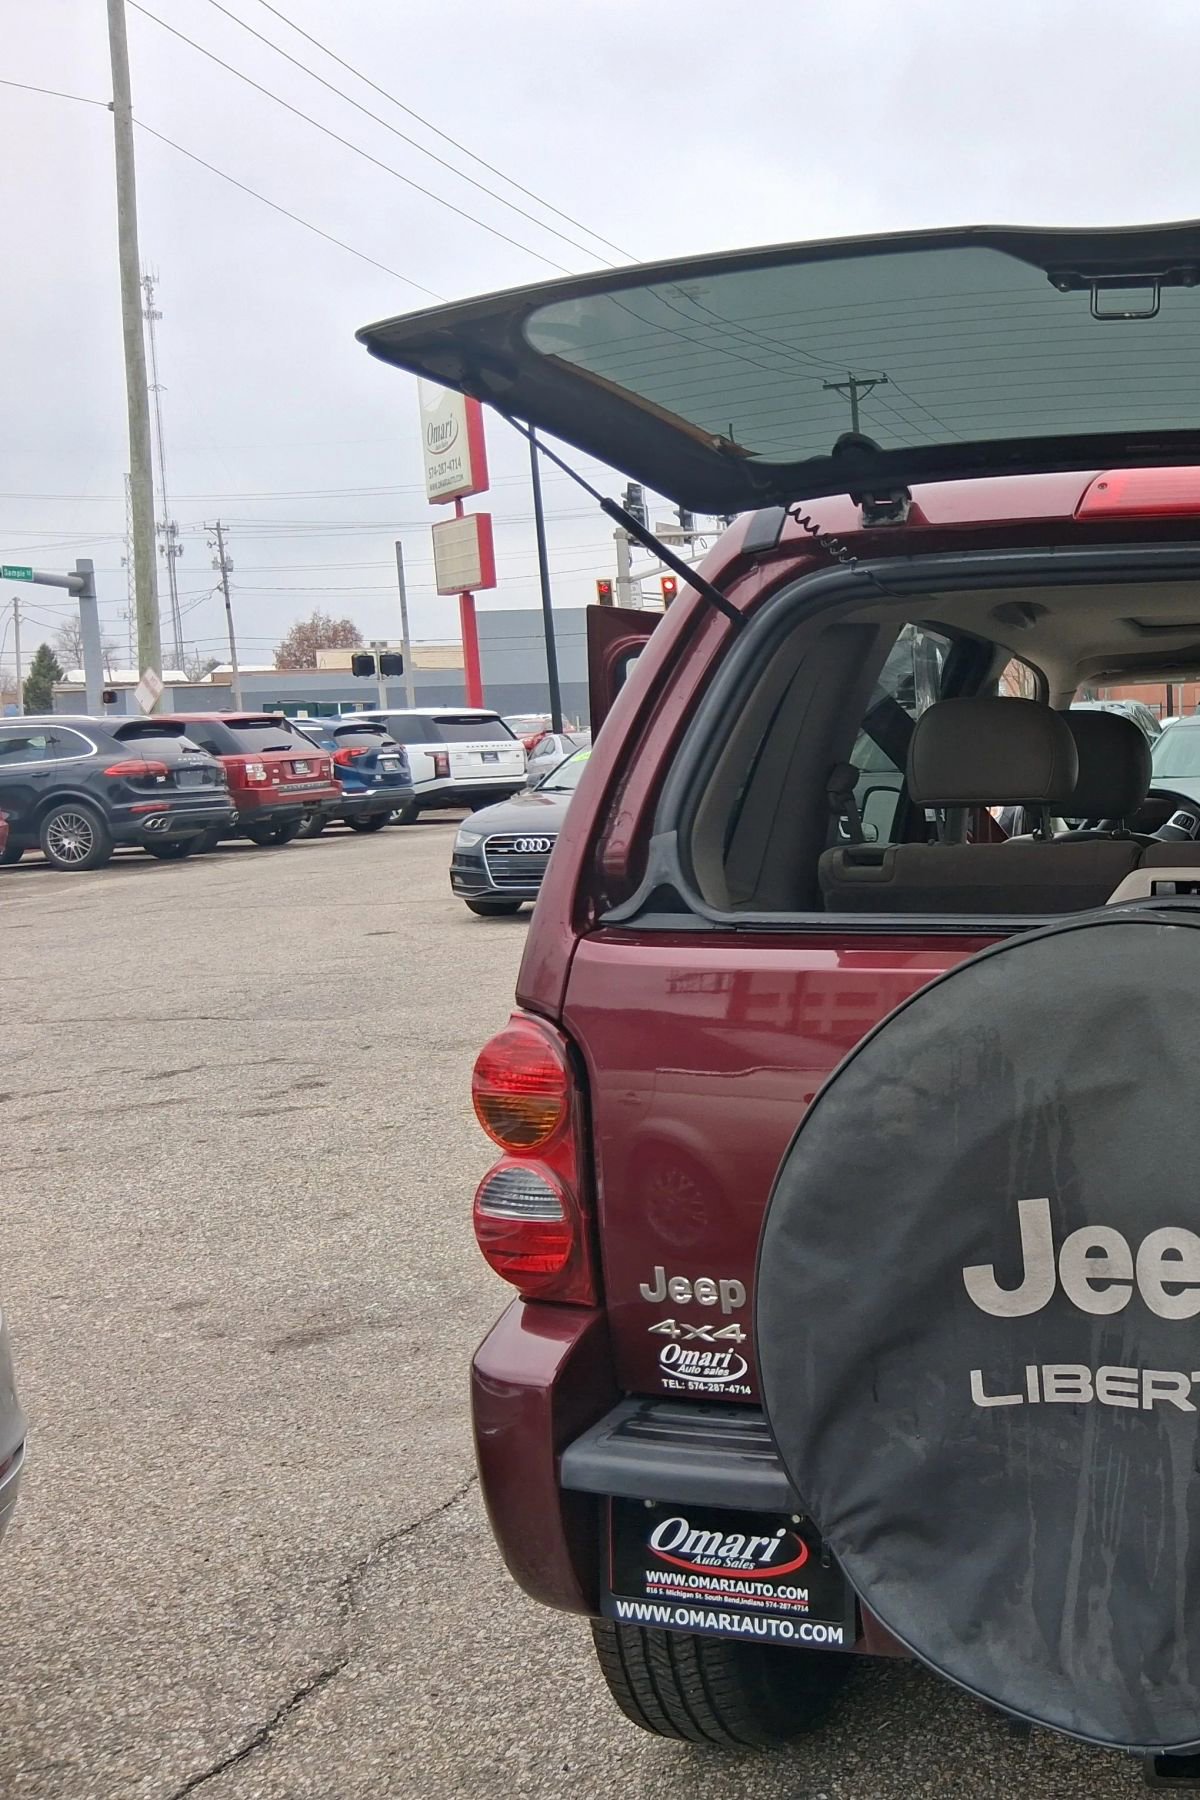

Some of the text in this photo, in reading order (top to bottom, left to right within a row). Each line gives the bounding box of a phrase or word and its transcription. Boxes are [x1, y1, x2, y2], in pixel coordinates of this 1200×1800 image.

[427, 413, 453, 446] Omari
[640, 1265, 746, 1314] Jeep
[660, 1343, 735, 1368] Omari
[677, 1364, 702, 1375] Auto
[661, 1378, 752, 1395] TEL: 574-287-4714
[651, 1517, 787, 1562] Omari
[691, 1555, 756, 1571] Auto Sales
[646, 1570, 809, 1602] WWW.OMARIAUTO.COM
[665, 1589, 694, 1599] Michigan
[765, 1600, 809, 1613] 574-287-4714
[616, 1600, 844, 1645] WWW.OMARIAUTO.COM
